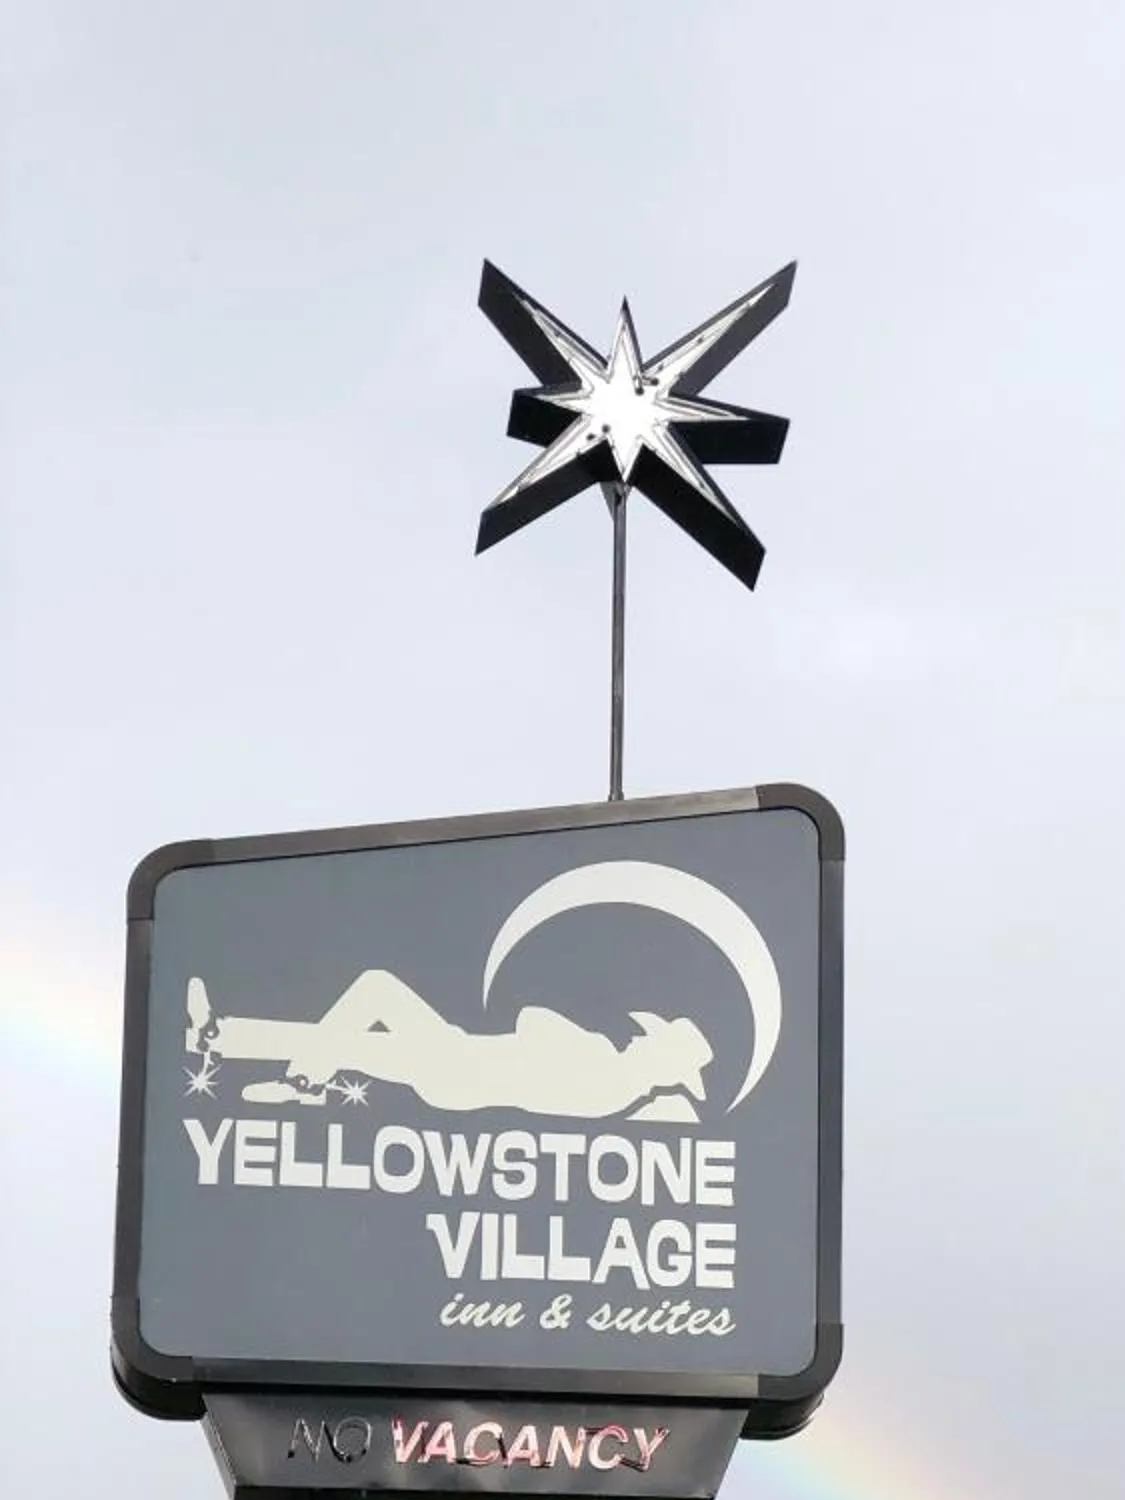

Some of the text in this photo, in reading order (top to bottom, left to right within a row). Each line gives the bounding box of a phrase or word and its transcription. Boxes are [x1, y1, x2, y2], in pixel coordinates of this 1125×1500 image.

[183, 1118, 736, 1207] YELLOWSTONE
[426, 1211, 736, 1289] VILLAGE
[440, 1292, 736, 1336] inn & suites
[288, 1414, 670, 1472] NO VACANCY
